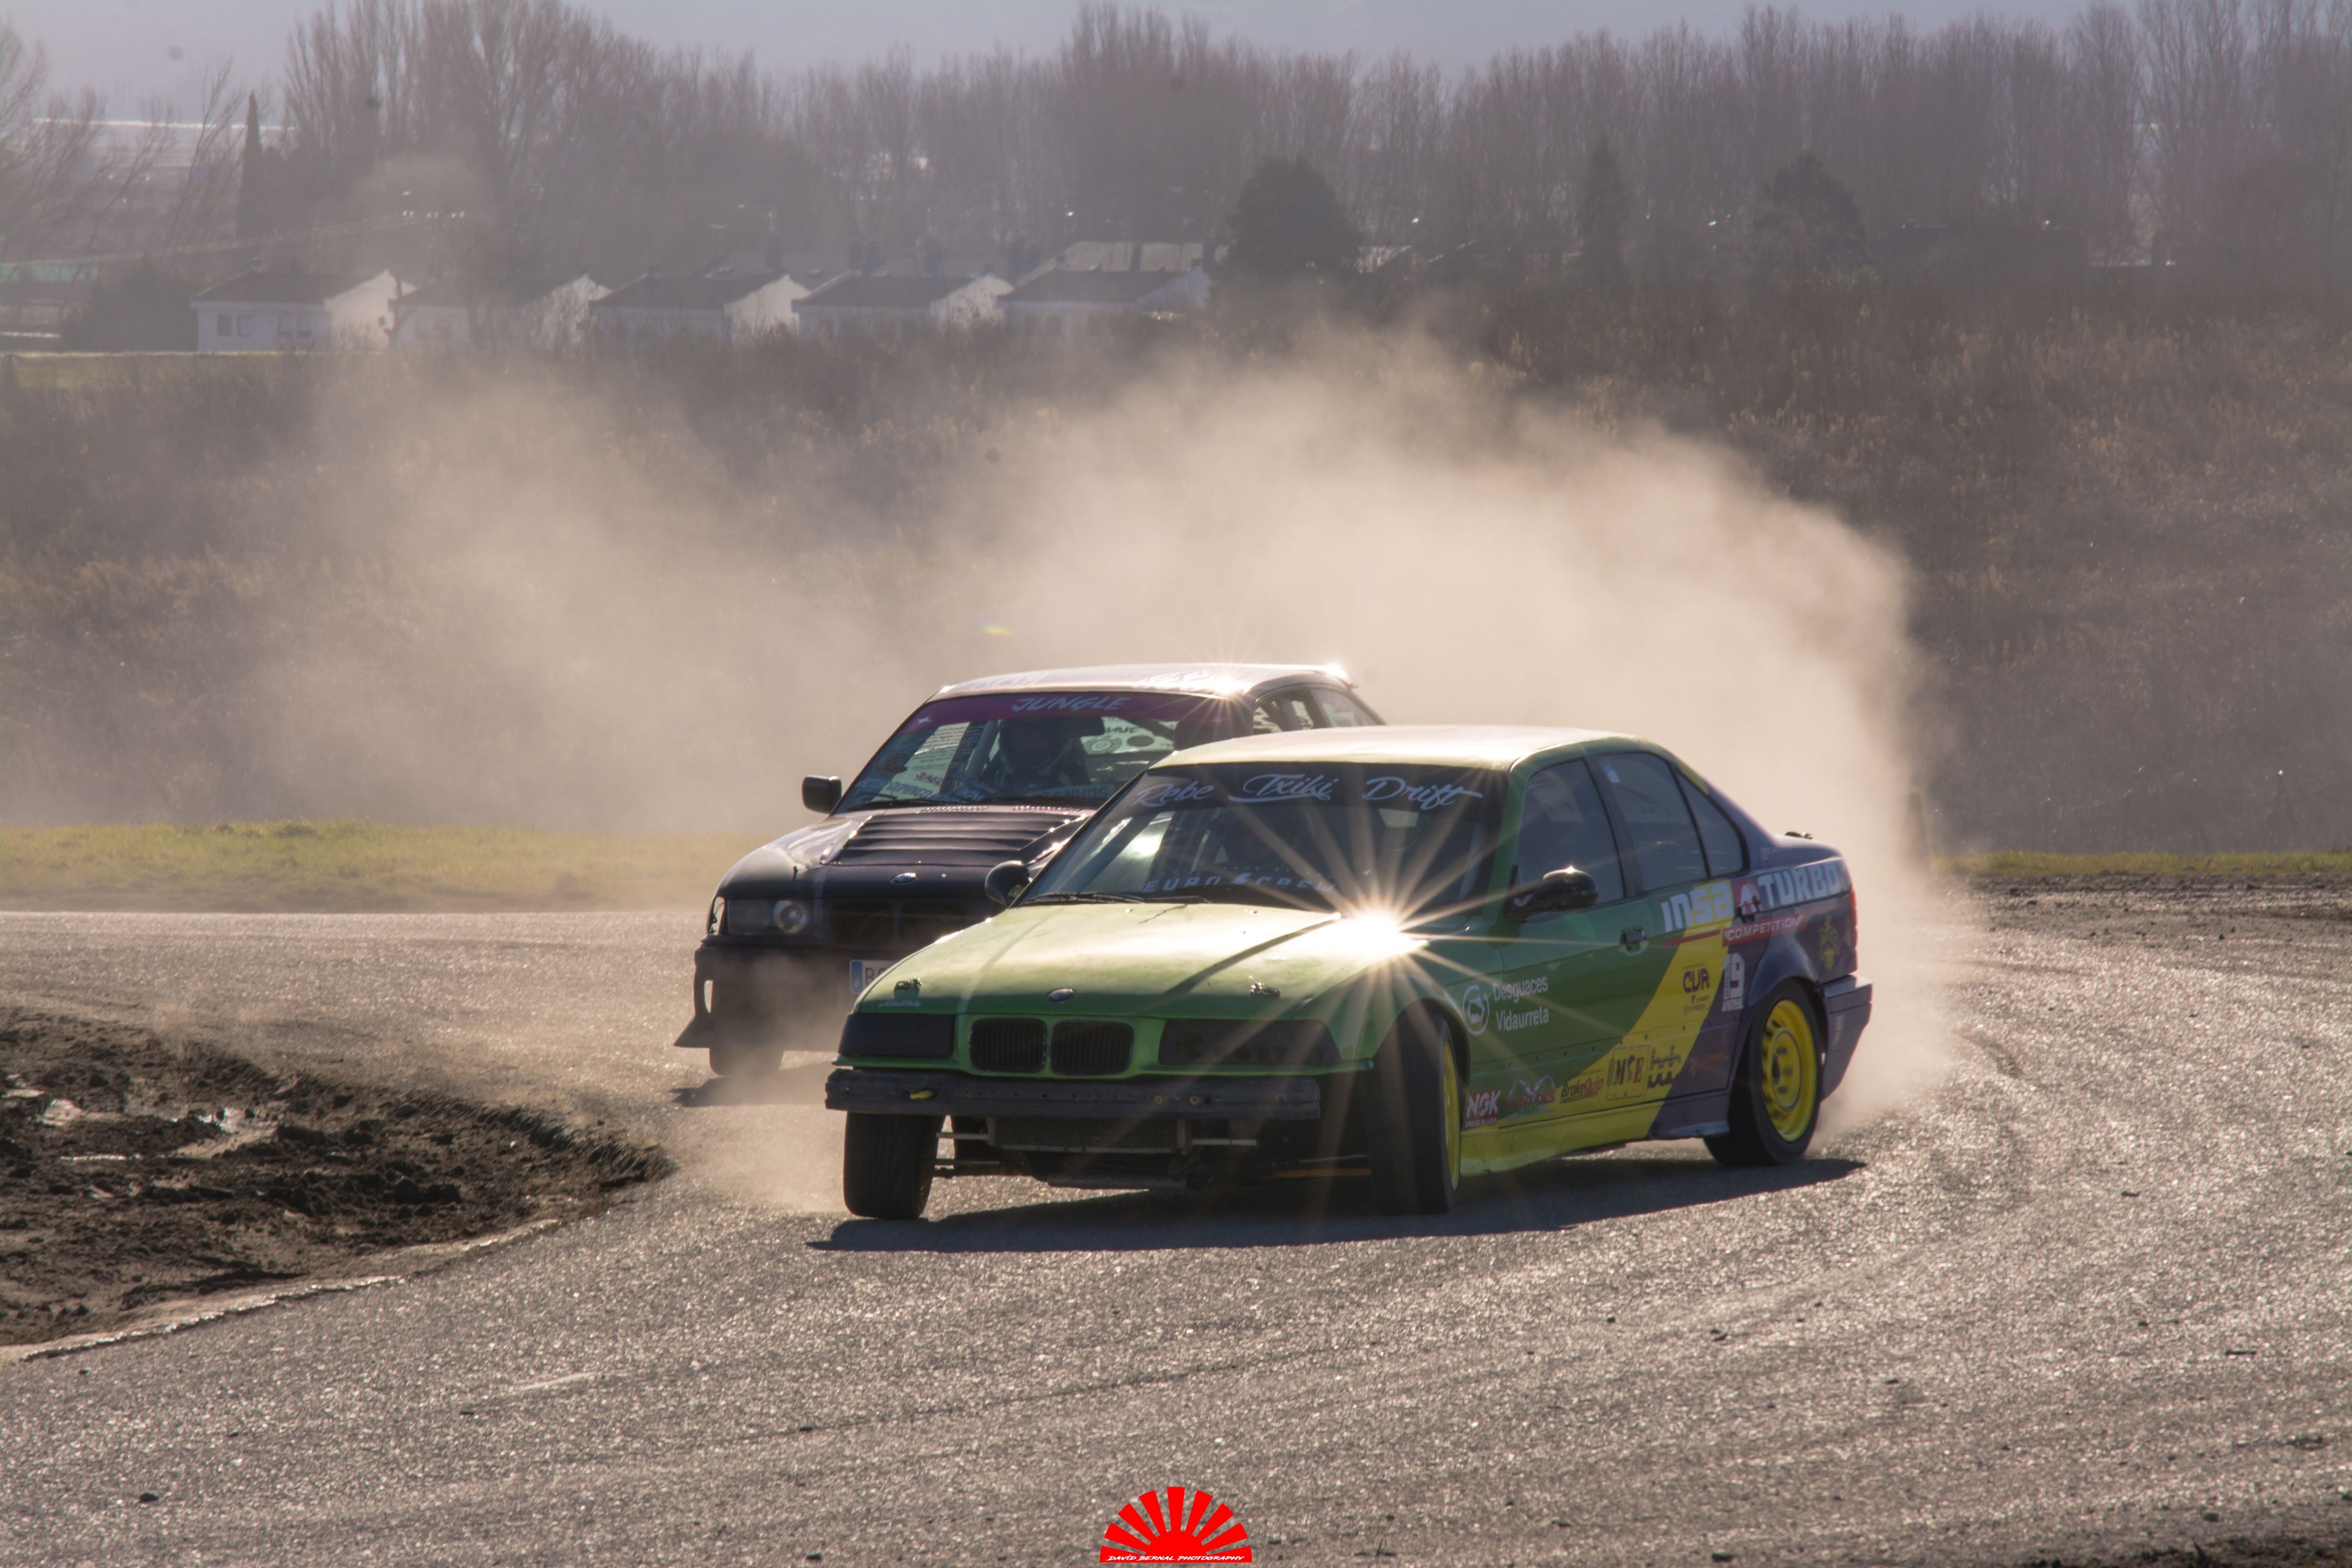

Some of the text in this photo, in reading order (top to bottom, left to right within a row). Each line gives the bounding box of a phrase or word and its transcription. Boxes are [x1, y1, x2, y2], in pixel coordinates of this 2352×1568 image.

[1011, 696, 1132, 713] JUNGLE
[1228, 774, 1339, 802] Txiki
[1363, 776, 1483, 810] Drift
[1757, 863, 1841, 909] TURBO
[1492, 976, 1548, 1003] Desguaces
[1495, 1006, 1549, 1032] Vidaurreta
[1561, 1075, 1604, 1098] BrakeQuip
[1466, 1090, 1502, 1119] NGK
